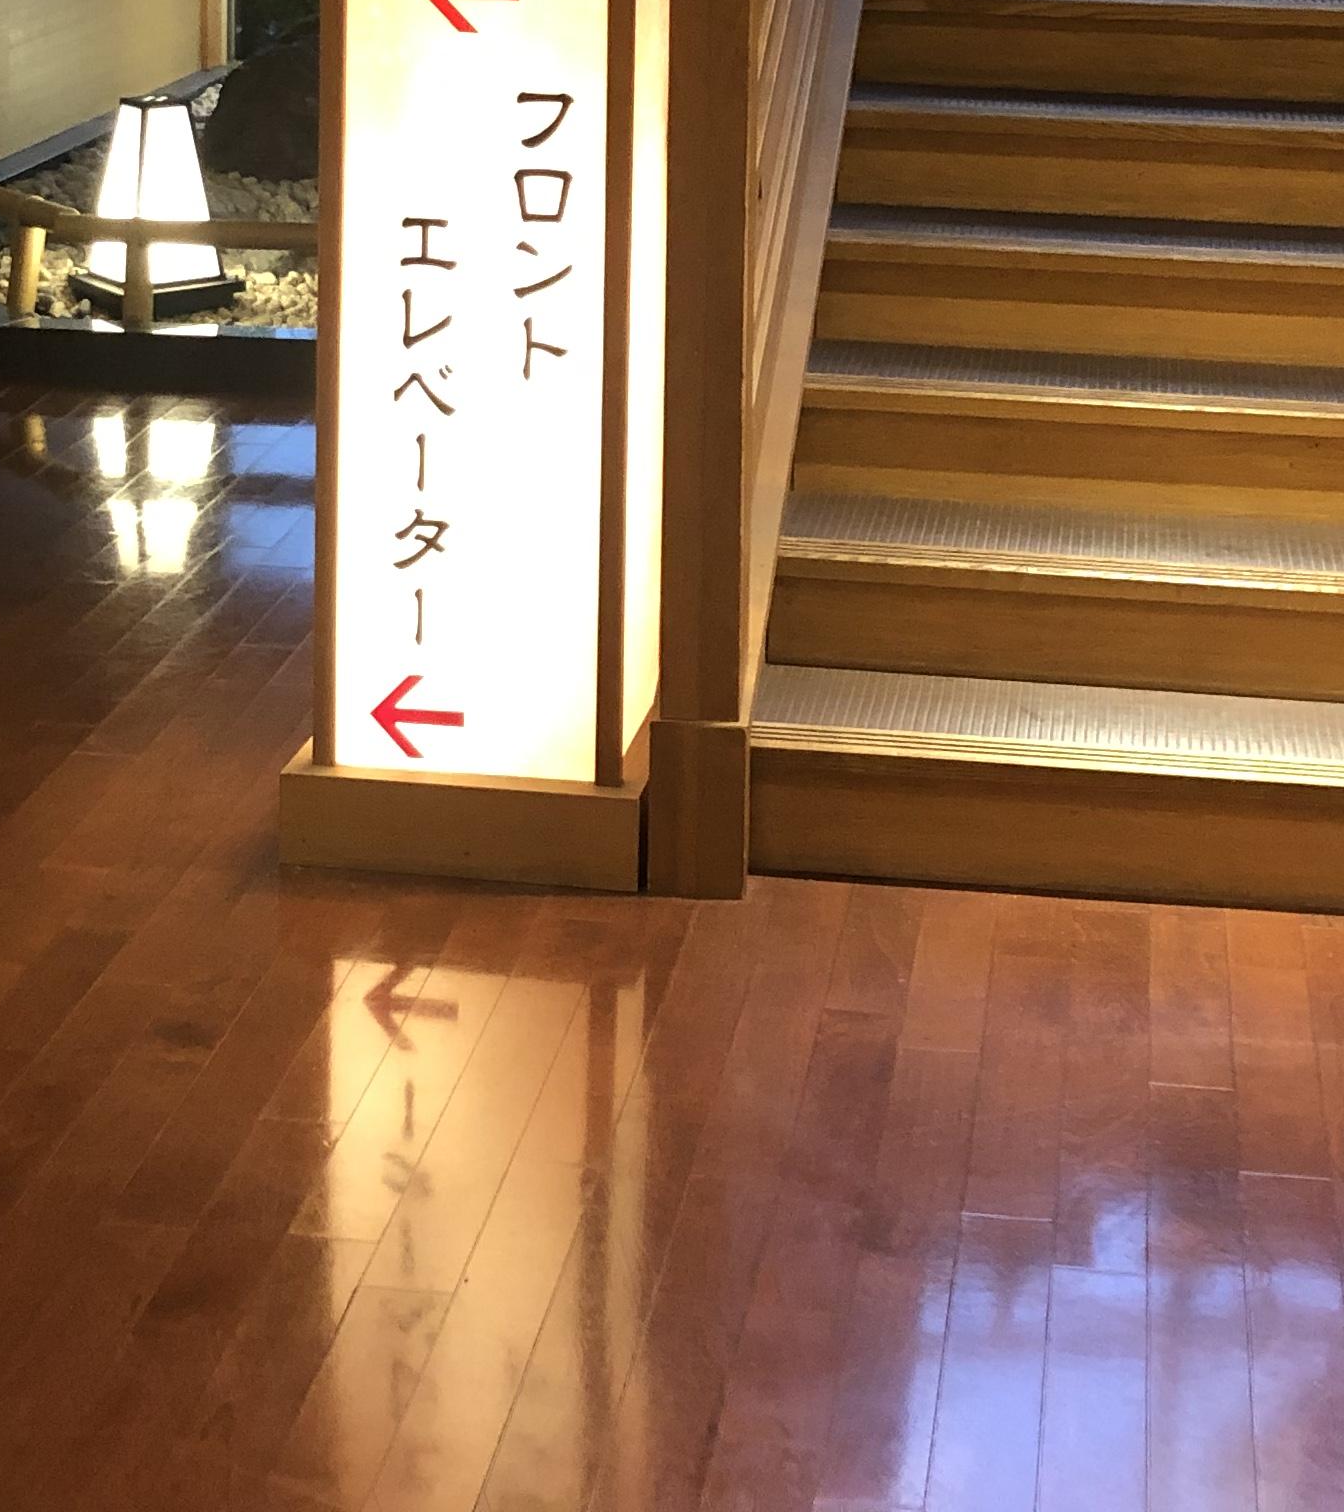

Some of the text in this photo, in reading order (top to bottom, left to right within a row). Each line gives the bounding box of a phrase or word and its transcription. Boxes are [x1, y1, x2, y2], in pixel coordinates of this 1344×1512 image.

[513, 90, 576, 382] フロント
[393, 217, 457, 646] エレベーター
